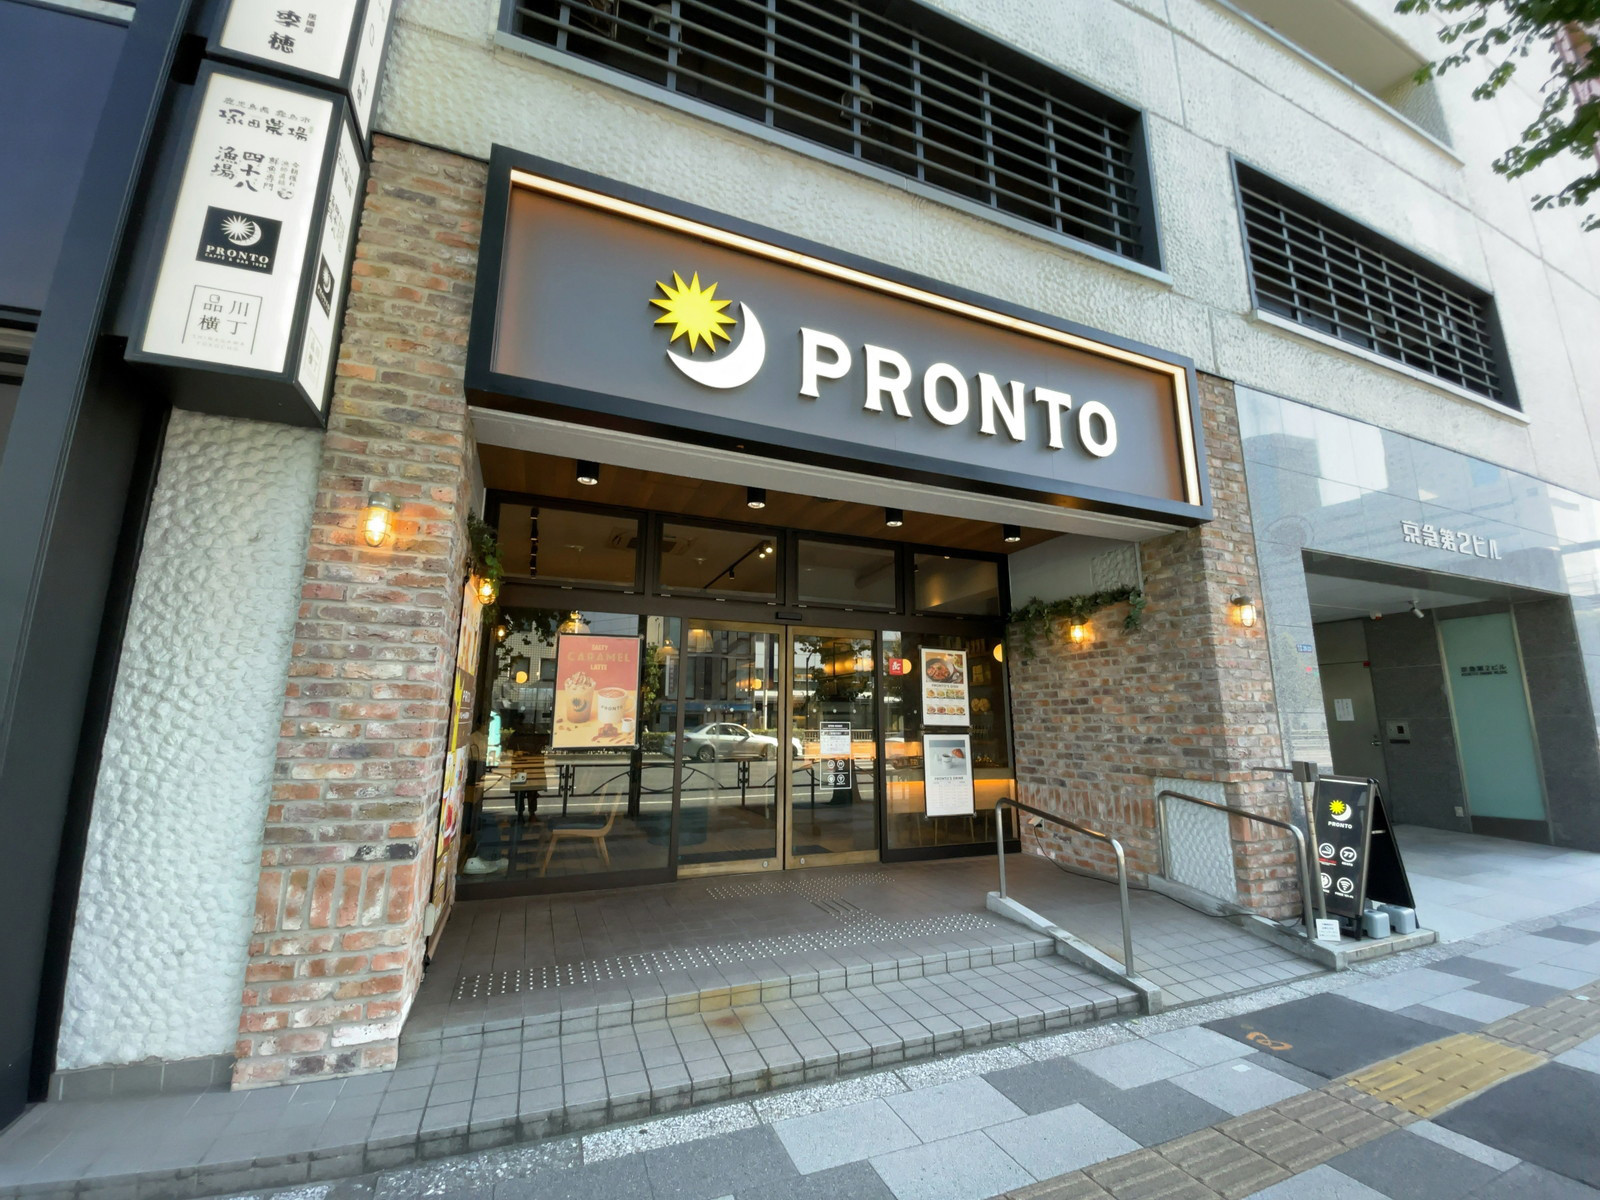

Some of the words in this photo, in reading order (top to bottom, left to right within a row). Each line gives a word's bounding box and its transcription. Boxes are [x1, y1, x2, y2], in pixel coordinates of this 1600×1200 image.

[210, 146, 239, 180] 漁場
[234, 151, 265, 192] 四十八
[205, 244, 269, 264] PRONTO
[203, 294, 249, 317] 品川
[198, 314, 247, 335] 横丁
[798, 326, 1118, 458] PRONTO
[1400, 519, 1502, 560] 京急第2ビル
[567, 652, 630, 662] CARAMEL
[1327, 821, 1353, 829] PRONTO
